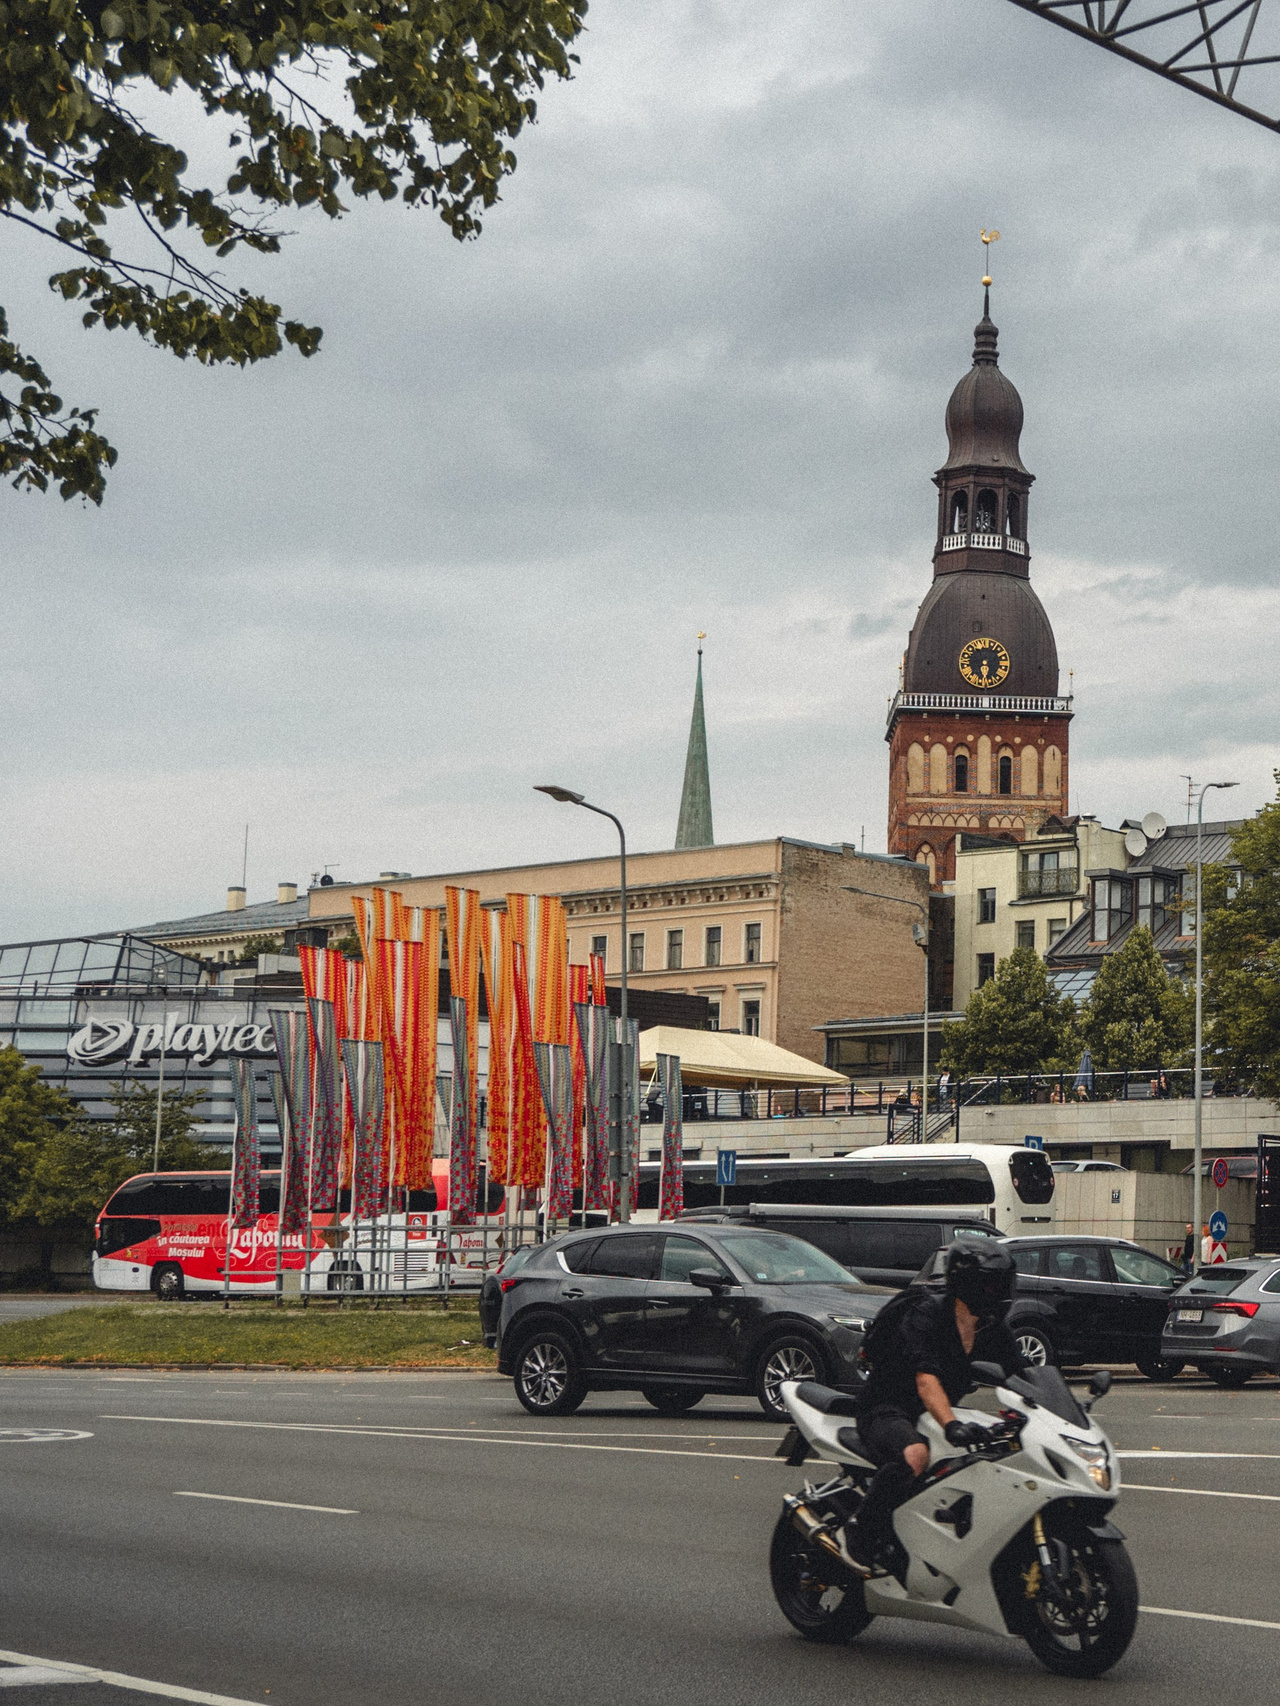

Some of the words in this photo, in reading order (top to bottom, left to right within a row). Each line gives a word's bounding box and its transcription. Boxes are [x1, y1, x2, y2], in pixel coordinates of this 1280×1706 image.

[127, 1011, 277, 1062] playtec
[168, 1232, 210, 1244] căutarea
[167, 1246, 206, 1261] Moșului
